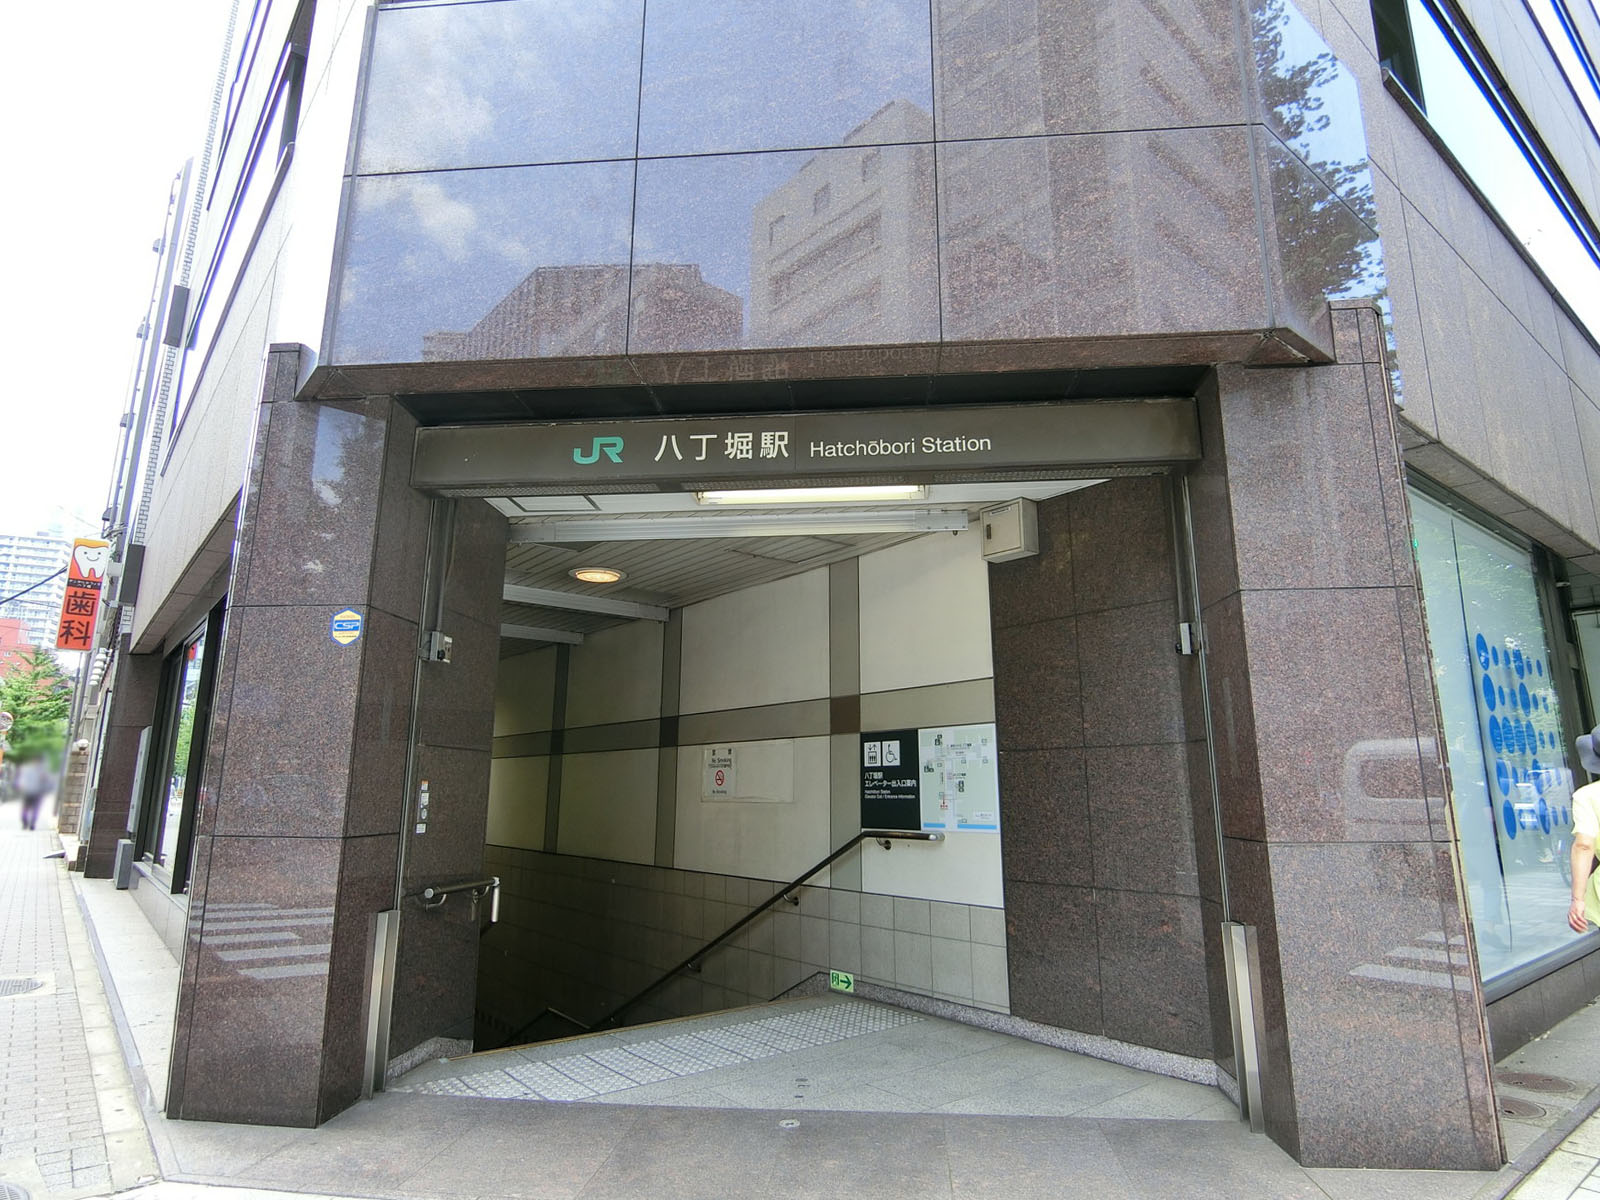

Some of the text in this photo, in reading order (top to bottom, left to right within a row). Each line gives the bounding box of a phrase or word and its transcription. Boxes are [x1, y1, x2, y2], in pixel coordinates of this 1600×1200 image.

[573, 436, 625, 465] JR
[654, 430, 790, 462] 八丁堀駅
[809, 435, 992, 458] Hatchōbori Station
[59, 590, 97, 647] 歯科
[335, 621, 360, 630] CSP
